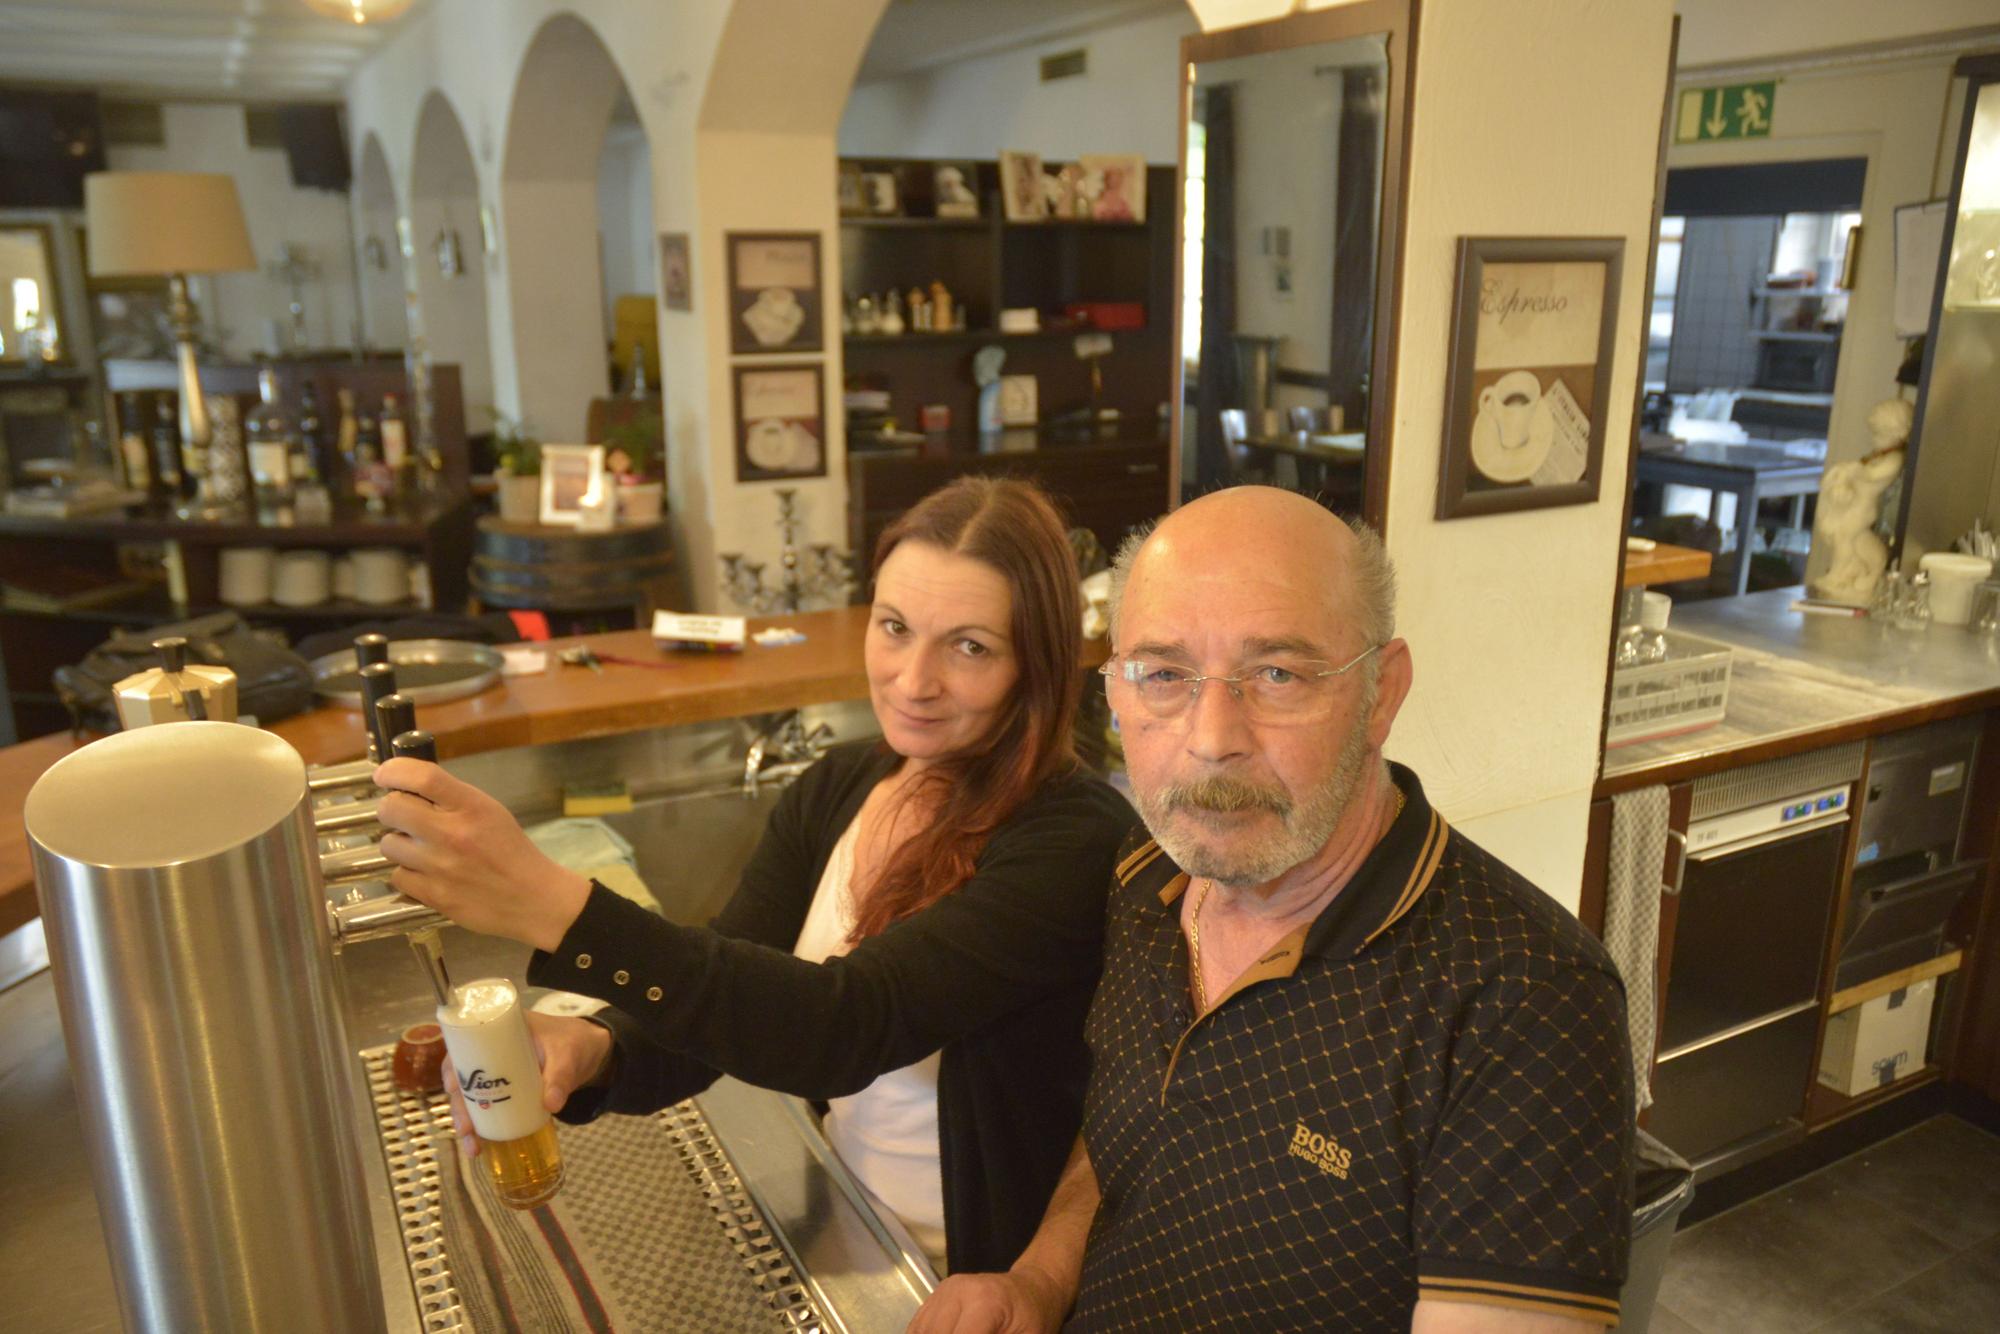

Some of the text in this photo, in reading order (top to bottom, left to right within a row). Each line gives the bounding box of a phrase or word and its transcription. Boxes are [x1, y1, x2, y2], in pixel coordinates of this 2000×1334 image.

[1480, 277, 1569, 325] Espresso
[1289, 1142, 1348, 1180] HUGO BOSS
[1292, 1123, 1352, 1170] BOSS
